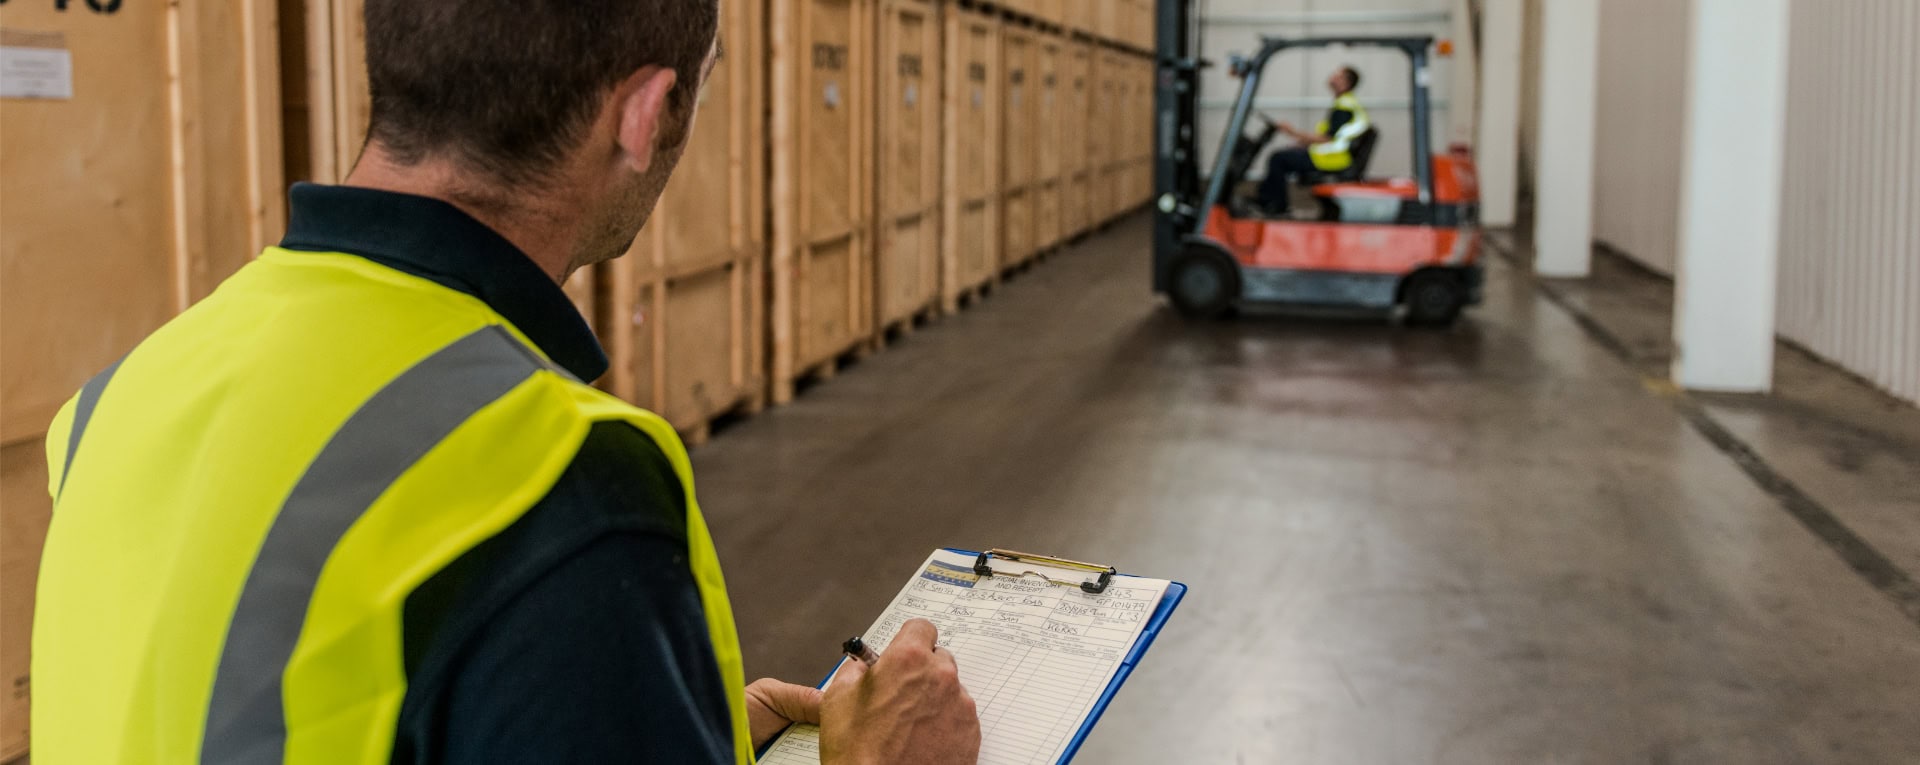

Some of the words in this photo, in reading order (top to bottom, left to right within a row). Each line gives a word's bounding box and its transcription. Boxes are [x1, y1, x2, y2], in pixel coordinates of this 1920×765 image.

[995, 582, 1010, 590] AND
[1010, 583, 1046, 593] RECEIPT
[950, 606, 976, 617] ANDY
